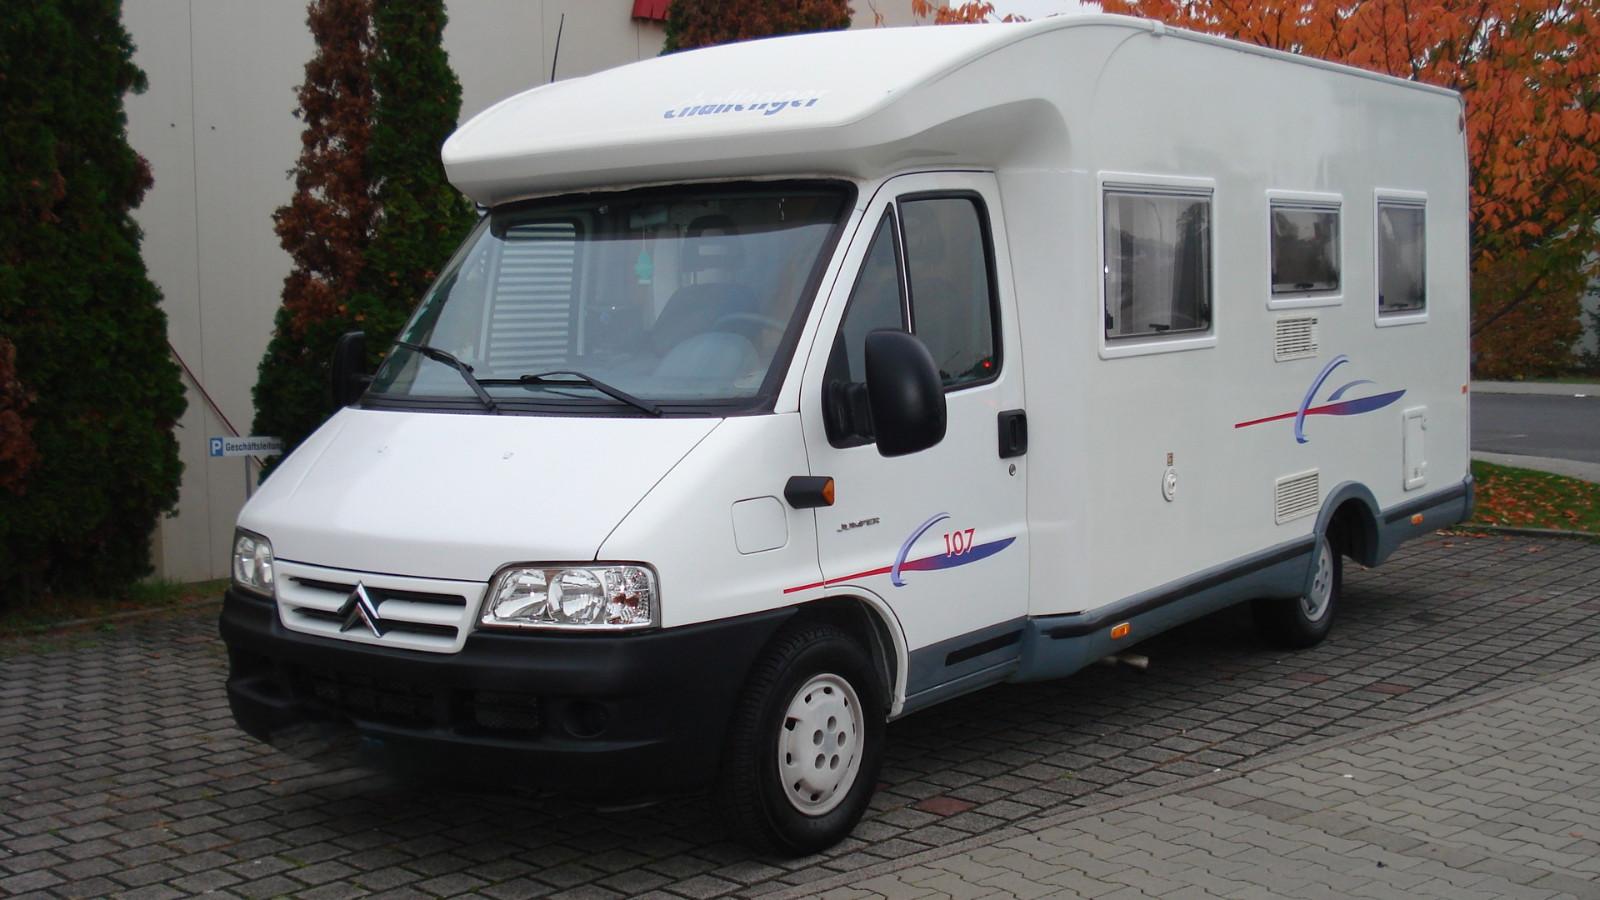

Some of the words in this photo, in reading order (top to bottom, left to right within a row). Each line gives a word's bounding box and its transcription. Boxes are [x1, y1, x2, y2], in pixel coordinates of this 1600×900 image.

[211, 440, 222, 455] P
[836, 517, 880, 532] JUMPER
[943, 528, 975, 557] 107
